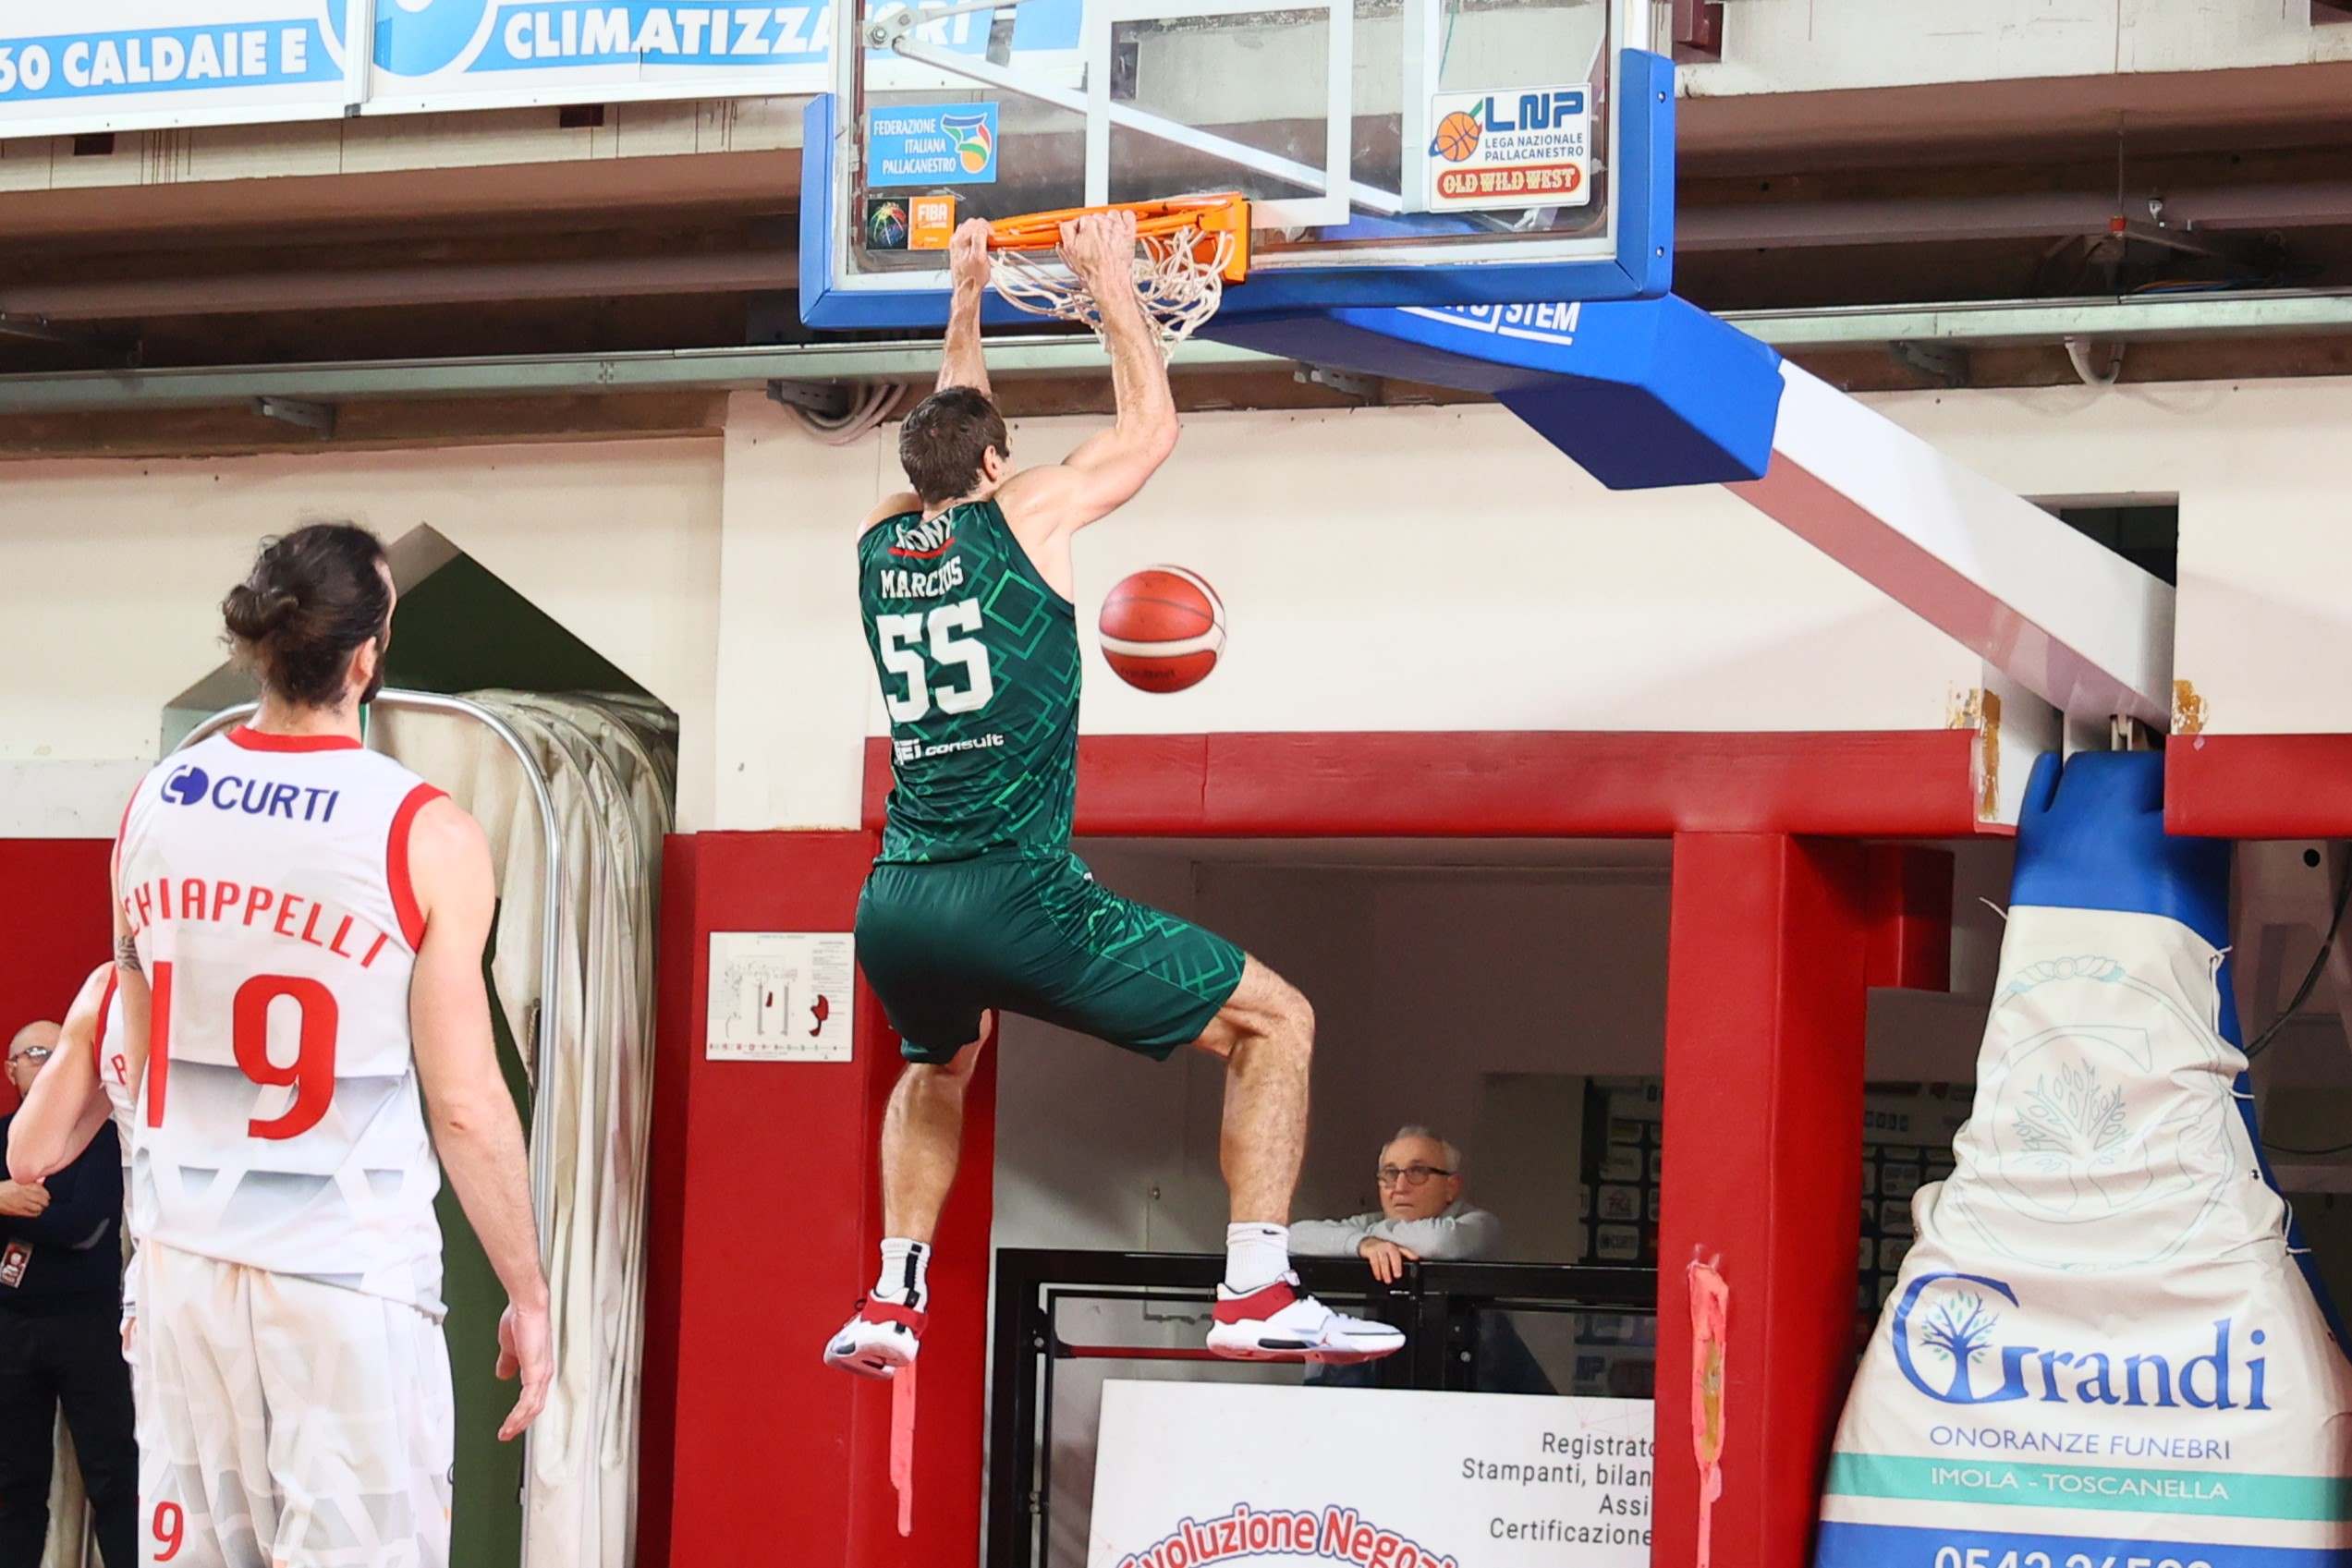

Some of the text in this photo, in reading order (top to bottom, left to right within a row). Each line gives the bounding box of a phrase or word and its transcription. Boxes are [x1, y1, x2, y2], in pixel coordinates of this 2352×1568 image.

[62, 30, 268, 88] CALDAIE
[280, 28, 307, 74] E
[873, 118, 936, 136] FEDERAZIONE
[1485, 91, 1584, 132] LNP
[905, 139, 946, 154] ITALIANA
[1484, 132, 1583, 150] LEGA NAZIONALE
[1484, 145, 1584, 162] PALLACANESTRO
[882, 157, 957, 175] PALLACANESTRO
[1442, 168, 1576, 194] OLD WILD WEST
[876, 597, 993, 723] 55
[924, 733, 1005, 758] consult
[212, 776, 340, 822] CURTI
[148, 961, 339, 1140] 19
[1892, 1271, 2272, 1410] Grandi
[1930, 1426, 2231, 1460] ONORANZE FUNEBRI
[1462, 1457, 1587, 1488] Stampanti,
[1931, 1467, 2019, 1489] IMOLA
[2042, 1473, 2229, 1500] TOSCANELLA
[152, 1501, 184, 1562] 9
[1116, 1506, 1316, 1568] voluzione
